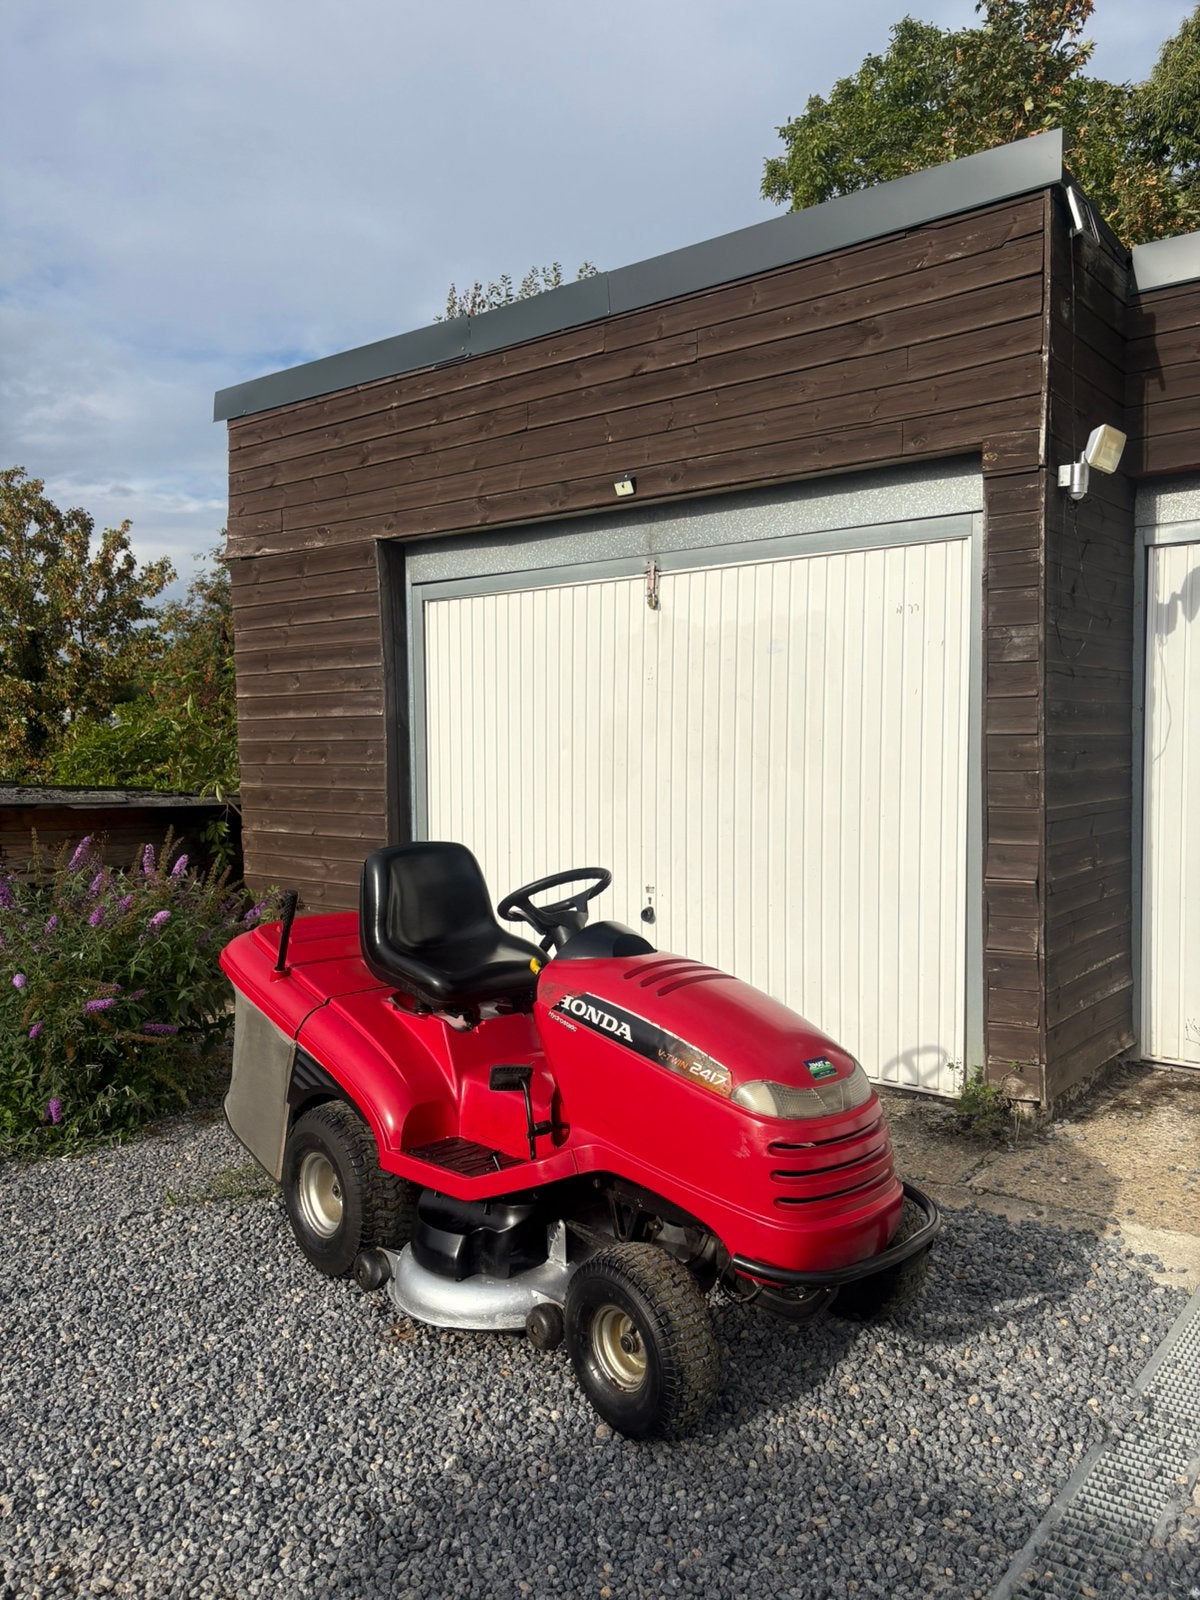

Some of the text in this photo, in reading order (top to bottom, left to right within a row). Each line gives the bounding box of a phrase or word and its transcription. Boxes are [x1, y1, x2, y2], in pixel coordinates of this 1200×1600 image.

[556, 994, 633, 1042] HONDA
[658, 1048, 727, 1085] V-TWIN 2417
